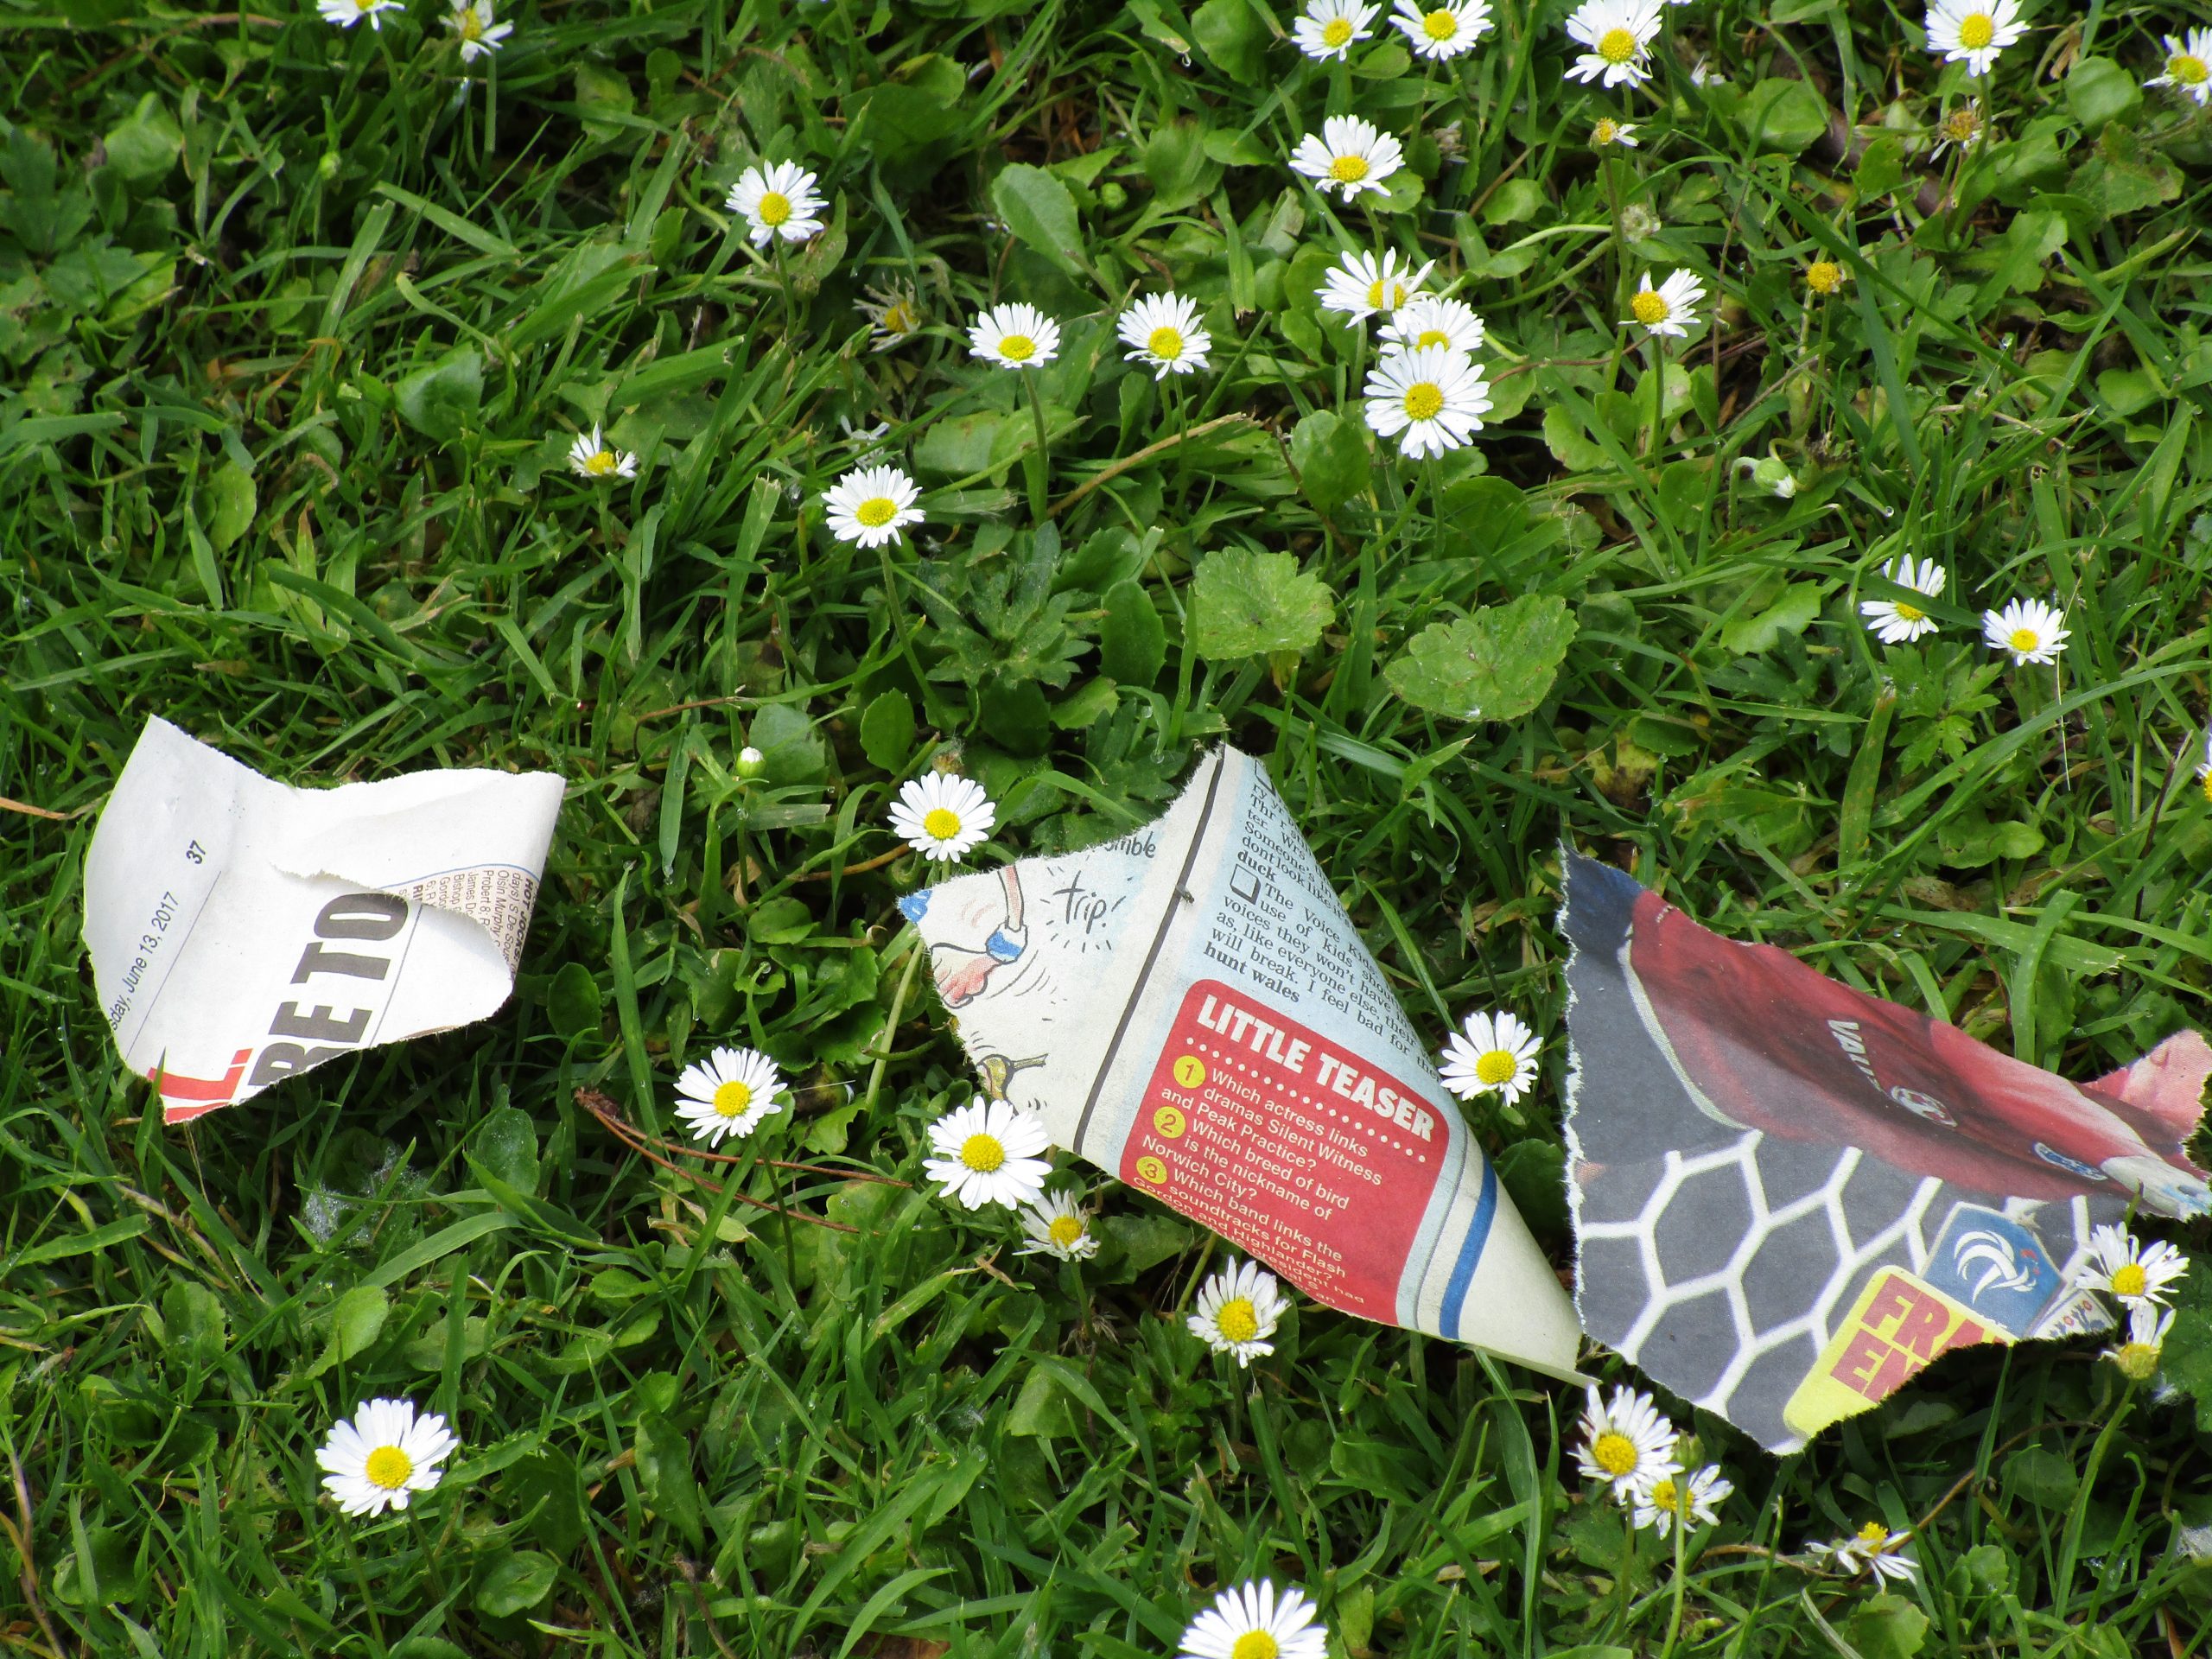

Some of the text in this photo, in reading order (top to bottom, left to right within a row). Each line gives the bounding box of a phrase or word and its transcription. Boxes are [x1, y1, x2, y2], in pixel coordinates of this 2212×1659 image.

[1250, 793, 1277, 821] Thr
[186, 839, 207, 865] 37
[1236, 849, 1277, 883] duck
[1242, 835, 1275, 865] dont
[1275, 857, 1306, 889] look
[1244, 820, 1316, 883] Someone's
[1281, 831, 1306, 861] Wrs
[150, 890, 180, 933] 2017
[451, 873, 466, 905] Bishop
[465, 871, 480, 900] James
[481, 869, 495, 904] Probert
[496, 869, 510, 898] Oisin
[508, 903, 519, 914] S
[509, 872, 522, 902] days)
[521, 877, 534, 911] HOT
[289, 893, 410, 985] TO
[490, 899, 507, 941] Murphy
[506, 916, 518, 932] De
[1260, 899, 1287, 923] use
[1296, 922, 1313, 938] of
[1322, 937, 1353, 968] kids
[1264, 882, 1294, 911] The
[1303, 907, 1340, 944] Voice
[139, 933, 163, 956] 13,
[1203, 943, 1301, 1003] hunt wales
[1224, 895, 1271, 931] voices
[1277, 925, 1311, 955] they
[1317, 952, 1355, 986] won't
[1360, 981, 1392, 1014] have
[121, 956, 148, 995] June
[1211, 927, 1243, 953] will
[1250, 946, 1299, 985] break.
[1306, 979, 1314, 994] I
[1321, 986, 1351, 1014] feel
[1357, 1010, 1383, 1037] bad
[1389, 1034, 1411, 1057] for
[1217, 911, 1237, 932] as,
[1243, 923, 1274, 950] like
[1277, 944, 1347, 995] everyone
[1350, 990, 1381, 1020] else,
[1385, 1014, 1418, 1048] their
[1197, 994, 1435, 1142] LITTLE TEASER
[1161, 1085, 1318, 1172] and Peak Practice?
[1185, 1063, 1369, 1158] 1 Which actress links
[1203, 1086, 1382, 1187] dramas Silent Witness
[1141, 1134, 1258, 1201] Norwich City?
[1160, 1114, 1350, 1211] 2 Which breed of bird
[1184, 1135, 1334, 1222] is the nickname of
[1133, 1176, 1194, 1214] Gordon
[1198, 1211, 1229, 1231] and
[1232, 1228, 1333, 1282] Highlander?
[1144, 1162, 1158, 1179] 3
[1173, 1167, 1224, 1204] Which
[1228, 1198, 1269, 1226] band
[1272, 1218, 1313, 1248] links
[1316, 1240, 1343, 1262] the
[1168, 1185, 1271, 1242] soundtracks
[1274, 1235, 1298, 1254] for
[1301, 1249, 1347, 1279] Flash
[1333, 1285, 1365, 1304] had
